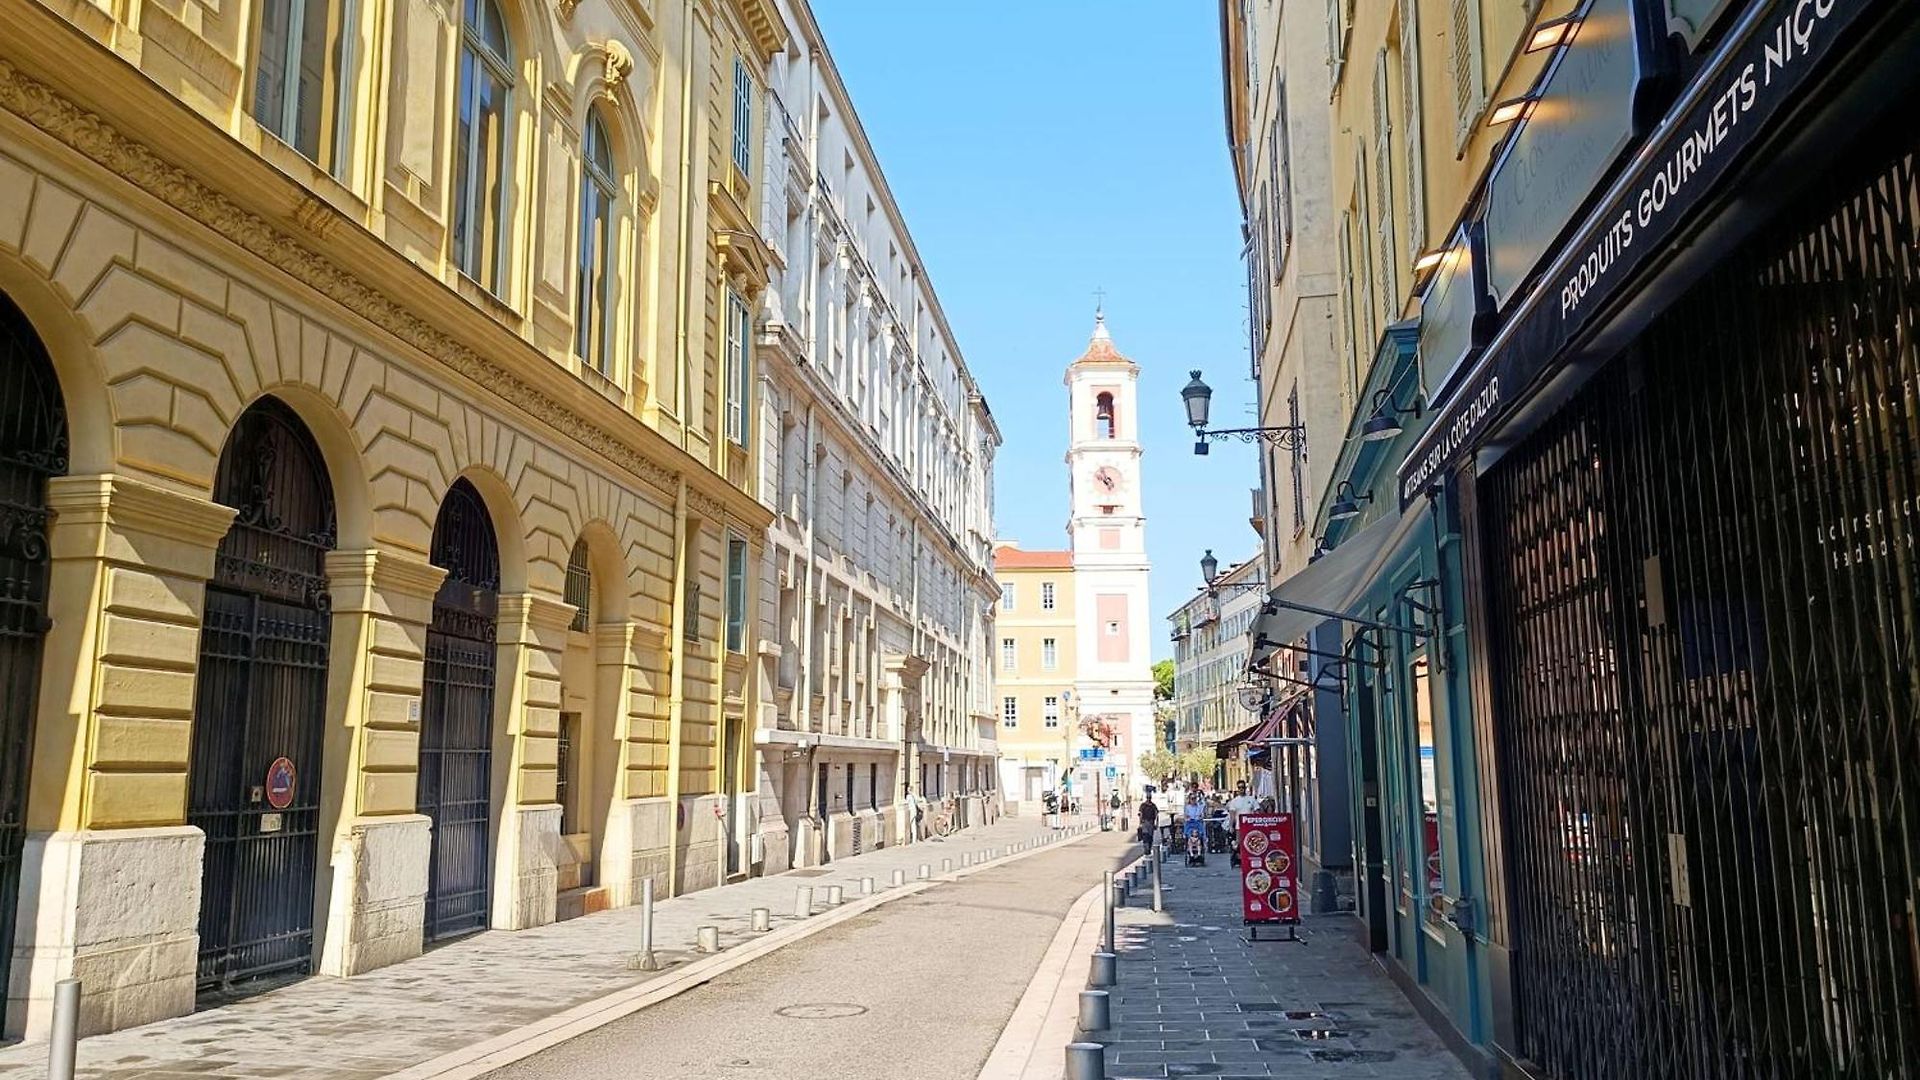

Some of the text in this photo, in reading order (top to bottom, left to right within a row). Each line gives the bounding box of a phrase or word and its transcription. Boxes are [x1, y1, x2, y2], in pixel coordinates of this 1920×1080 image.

[1562, 210, 1632, 319] PRODUITS
[1637, 63, 1756, 228] GOURMETS
[1429, 444, 1440, 474] SUR
[1451, 410, 1470, 449] CÔTE
[1470, 376, 1499, 428] D'AZUR
